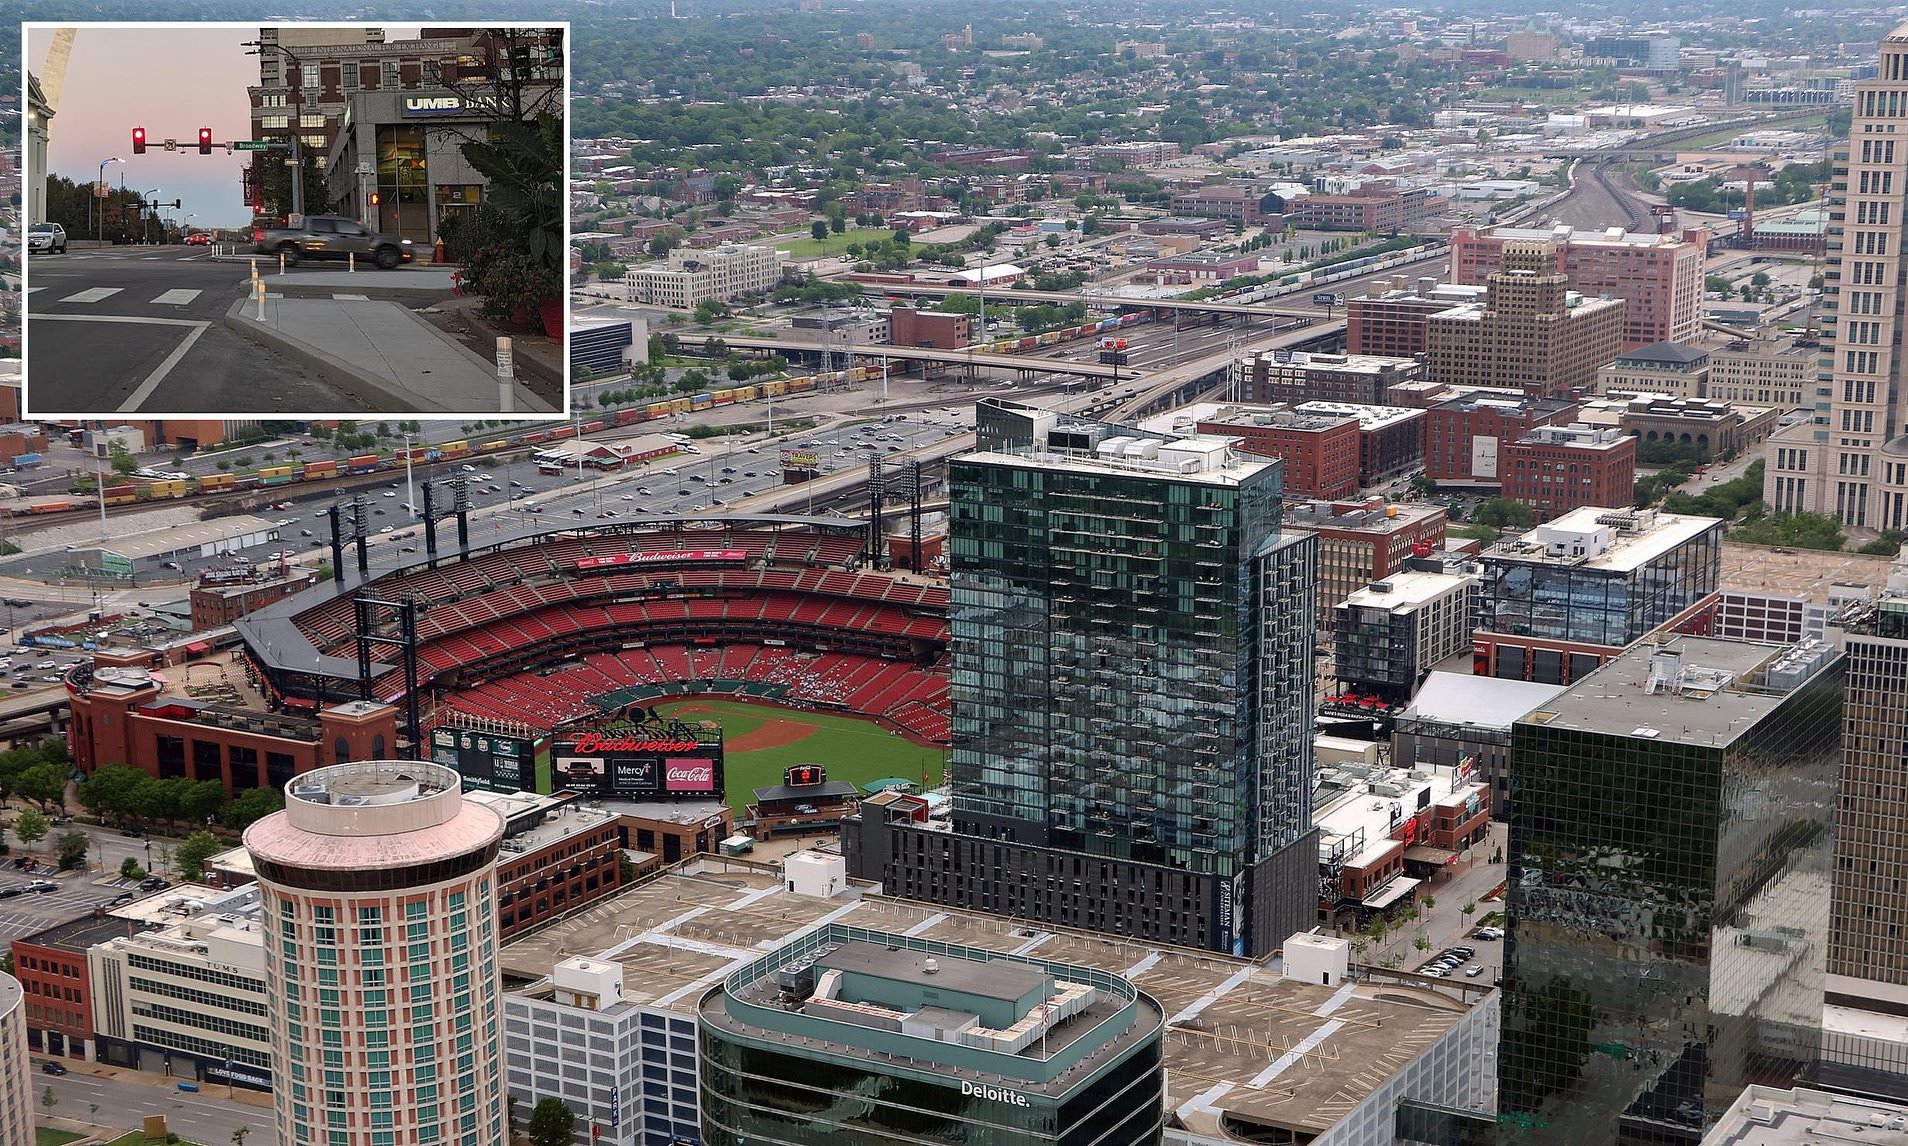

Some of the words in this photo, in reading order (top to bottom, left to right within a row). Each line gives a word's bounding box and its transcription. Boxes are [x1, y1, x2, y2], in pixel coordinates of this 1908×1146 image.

[406, 97, 460, 110] UMB
[239, 141, 266, 150] Broadway
[452, 191, 462, 199] 2
[625, 551, 694, 562] Budweiser
[570, 732, 698, 753] Budweiser
[617, 765, 644, 776] Mercy
[666, 767, 712, 782] Coca-Cola
[462, 775, 491, 785] Smithfield
[206, 962, 239, 974] TUMS
[961, 1080, 1031, 1108] Deloitte.
